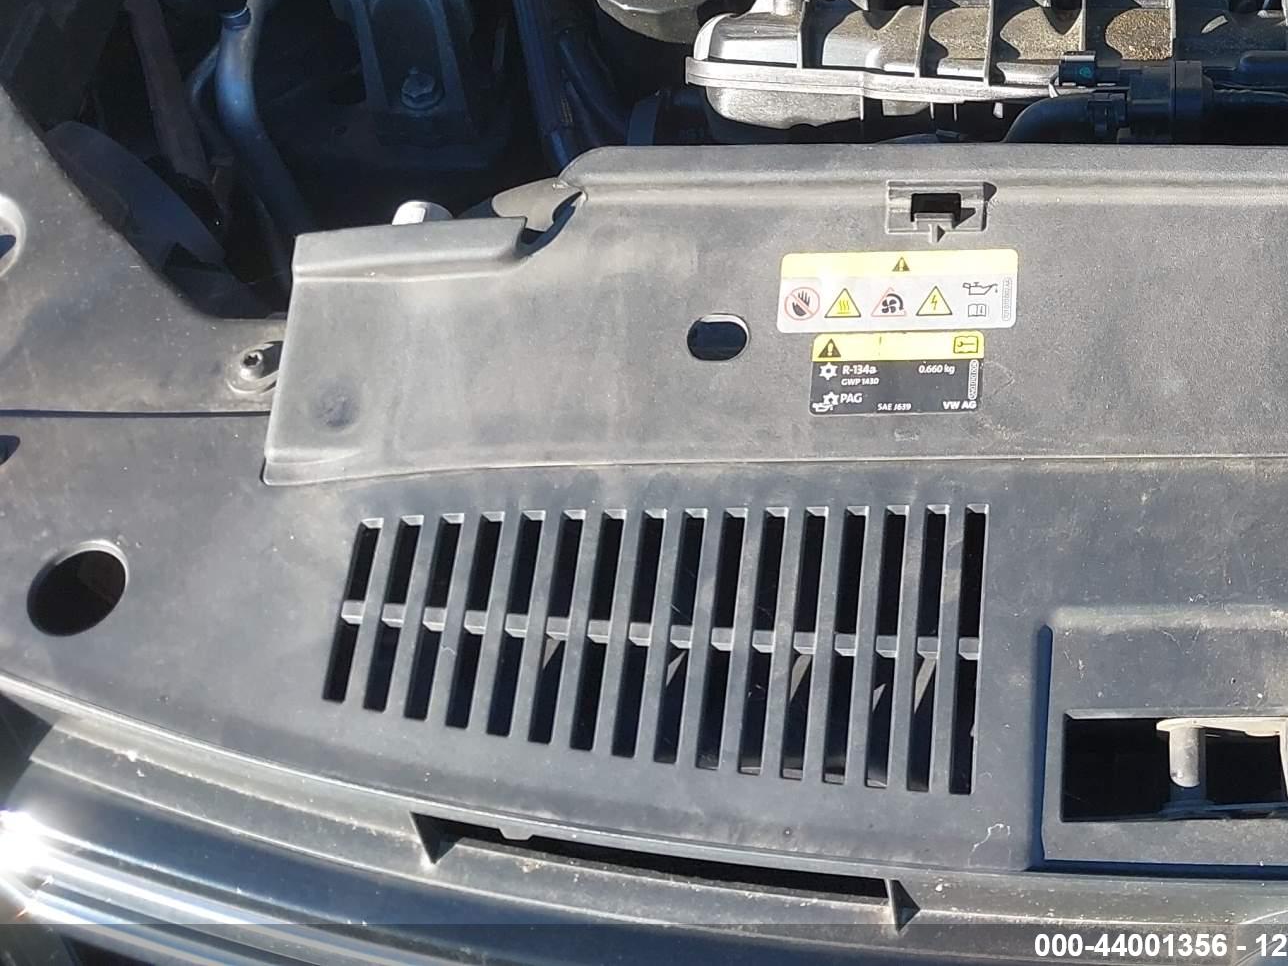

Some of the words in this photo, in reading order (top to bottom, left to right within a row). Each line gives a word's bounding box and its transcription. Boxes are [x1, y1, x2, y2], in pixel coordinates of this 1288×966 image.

[842, 364, 878, 375] R-134a
[918, 364, 943, 374] 0.660
[944, 364, 956, 376] kg
[841, 378, 861, 386] GWP
[861, 377, 880, 385] 1430
[840, 393, 863, 404] PAG
[877, 402, 893, 411] SAE
[943, 401, 960, 410] VW
[961, 400, 977, 410] AG
